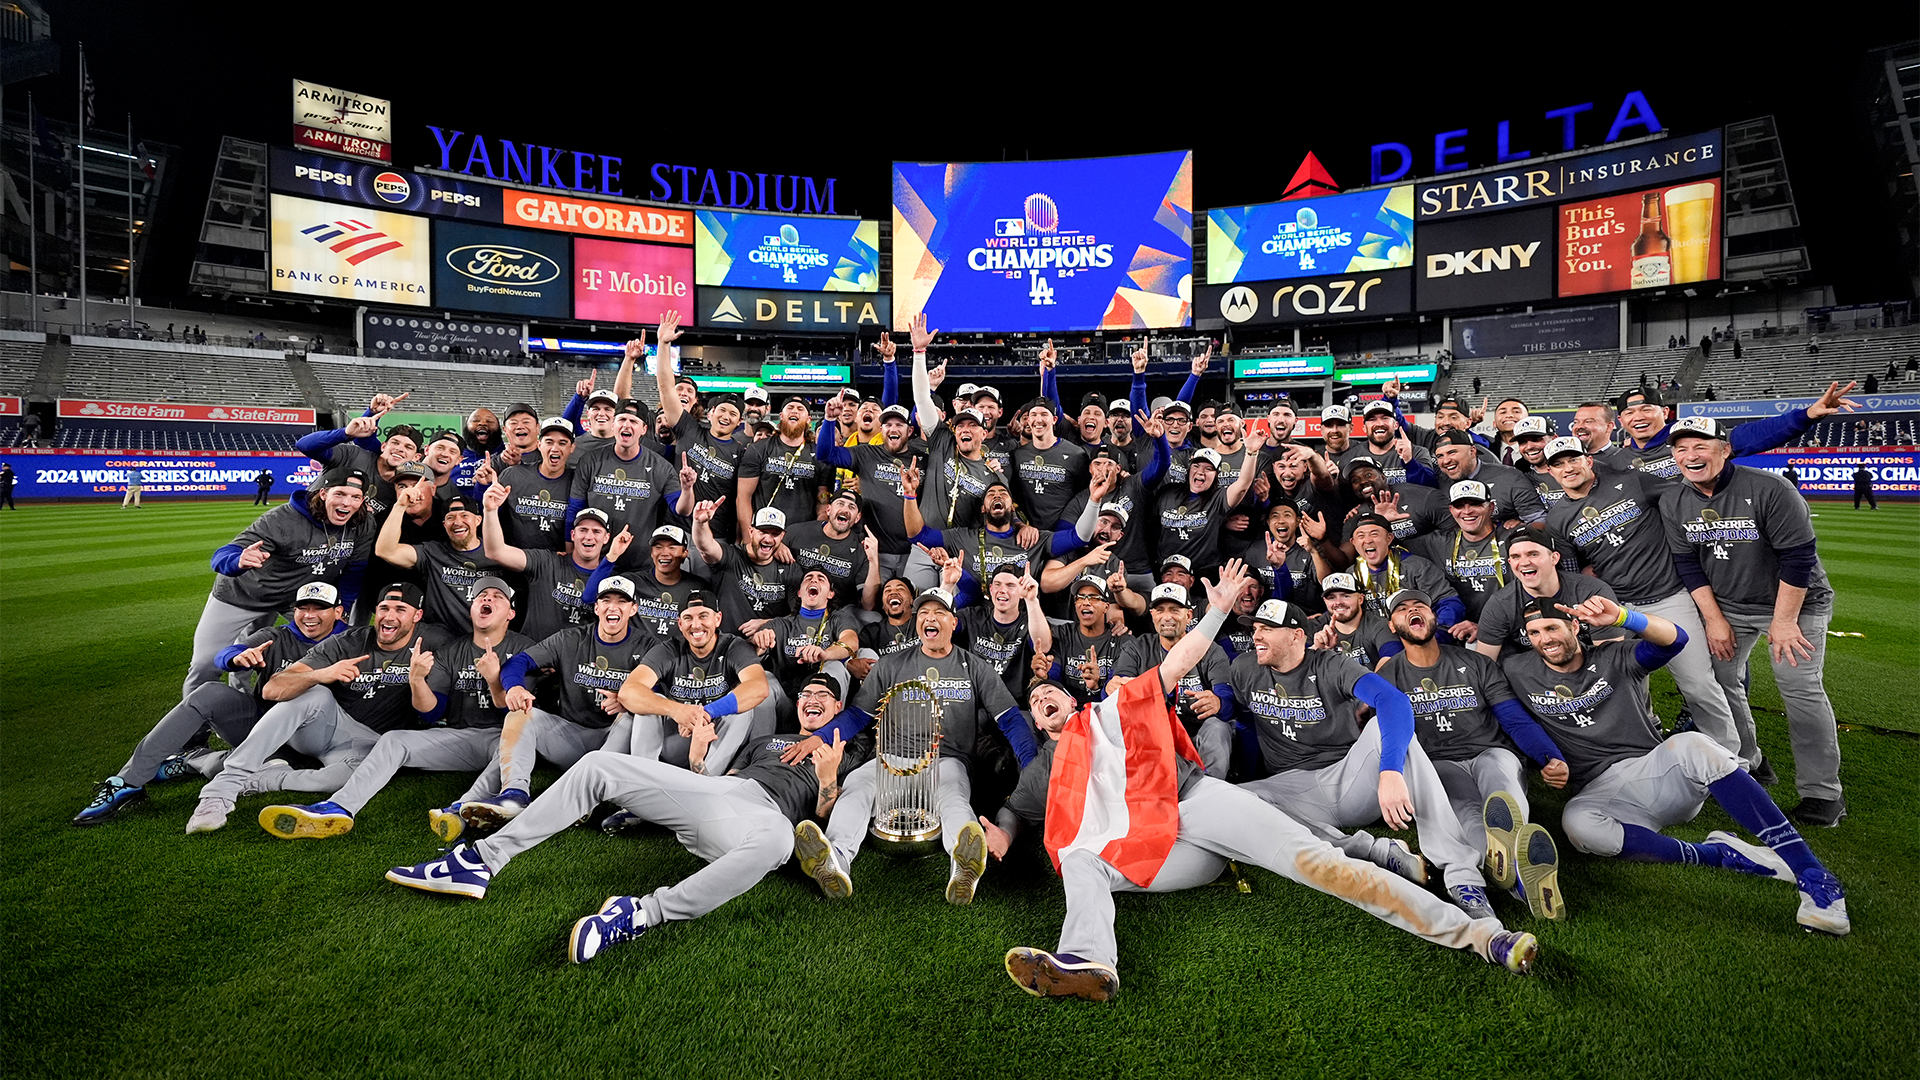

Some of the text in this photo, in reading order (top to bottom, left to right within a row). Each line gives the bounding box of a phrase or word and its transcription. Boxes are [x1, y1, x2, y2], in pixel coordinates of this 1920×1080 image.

[298, 88, 386, 115] ARMITRON
[303, 129, 381, 152] ARMITRON
[1371, 89, 1663, 184] DELTA
[342, 145, 381, 158] WATCHES
[295, 165, 352, 187] PEPSI
[426, 125, 837, 214] YANKEE STADIUM
[376, 181, 408, 194] PEPSI
[1420, 144, 1715, 216] STARR INSURANCE
[431, 189, 481, 208] PEPSI
[516, 198, 685, 237] GATORADE
[1565, 204, 1616, 225] This
[1272, 227, 1341, 240] WORLD SERIES
[1565, 219, 1626, 241] Bud's
[985, 235, 1096, 248] WORLD SERIES
[1261, 232, 1352, 254] CHAMPIONS
[748, 250, 829, 266] CHAMPIONS
[789, 246, 820, 254] SERIES
[967, 244, 1114, 271] CHAMPIONS
[1565, 242, 1603, 258] For
[468, 248, 539, 281] Ford
[1299, 250, 1316, 270] LA
[1426, 241, 1541, 278] DKNY
[1565, 259, 1612, 274] You.
[276, 268, 426, 294] BANK OF AMERICA
[782, 264, 799, 283] LA
[1005, 269, 1075, 279] 20 24
[467, 284, 541, 298] BuyFordNow.com
[582, 268, 687, 298] T Mobile
[1029, 269, 1054, 305] LA
[1272, 277, 1382, 318] razr
[755, 298, 880, 324] DELTA
[413, 330, 478, 344] New York Yankees
[1522, 339, 1582, 352] THE BOSS
[106, 404, 185, 419] State Farm
[230, 408, 299, 421] State Farm
[1707, 405, 1752, 413] FANDUEL
[687, 448, 733, 480] CHAMPIONS
[692, 443, 735, 473] WORLD SERIES
[1787, 457, 1914, 465] CONGRATULATIONS
[36, 469, 189, 484] 2024 WORL SERIES
[699, 469, 709, 484] LA
[1018, 469, 1066, 482] CHAMPIONS
[1019, 463, 1066, 474] WORLD SERIES
[594, 476, 651, 489] WORLD SERIES
[784, 476, 795, 490] LA
[1034, 479, 1045, 494] LA
[592, 484, 651, 499] CHAMPIONS
[517, 497, 550, 508] WORLD
[614, 496, 626, 511] LA
[539, 516, 550, 531] LA
[1184, 510, 1207, 521] SERIES
[1569, 499, 1636, 537] WORLD SERIES
[1574, 506, 1642, 546] CHAMPIONS
[1718, 519, 1756, 529] SERIES
[1178, 528, 1190, 540] LA
[1606, 531, 1624, 547] LA
[1686, 528, 1759, 542] CHAMPIONS
[1002, 552, 1028, 563] SERIES
[1713, 541, 1730, 560] LA
[800, 548, 853, 570] WORLD SERIES
[442, 566, 476, 578] WORLD
[1469, 577, 1485, 591] LA
[639, 599, 669, 609] WORLD
[569, 607, 581, 623] LA
[657, 618, 669, 635] LA
[976, 636, 1002, 651] WORLD
[938, 679, 971, 688] SERIES
[1438, 686, 1475, 697] SERIES
[477, 691, 489, 708] LA
[1250, 691, 1323, 708] WORLD SERIES
[1531, 684, 1613, 714] CHAMPIONS
[1249, 701, 1327, 721] CHAMPIONS
[1436, 712, 1453, 732] LA
[1570, 712, 1596, 728] LA
[1280, 719, 1297, 742] LA
